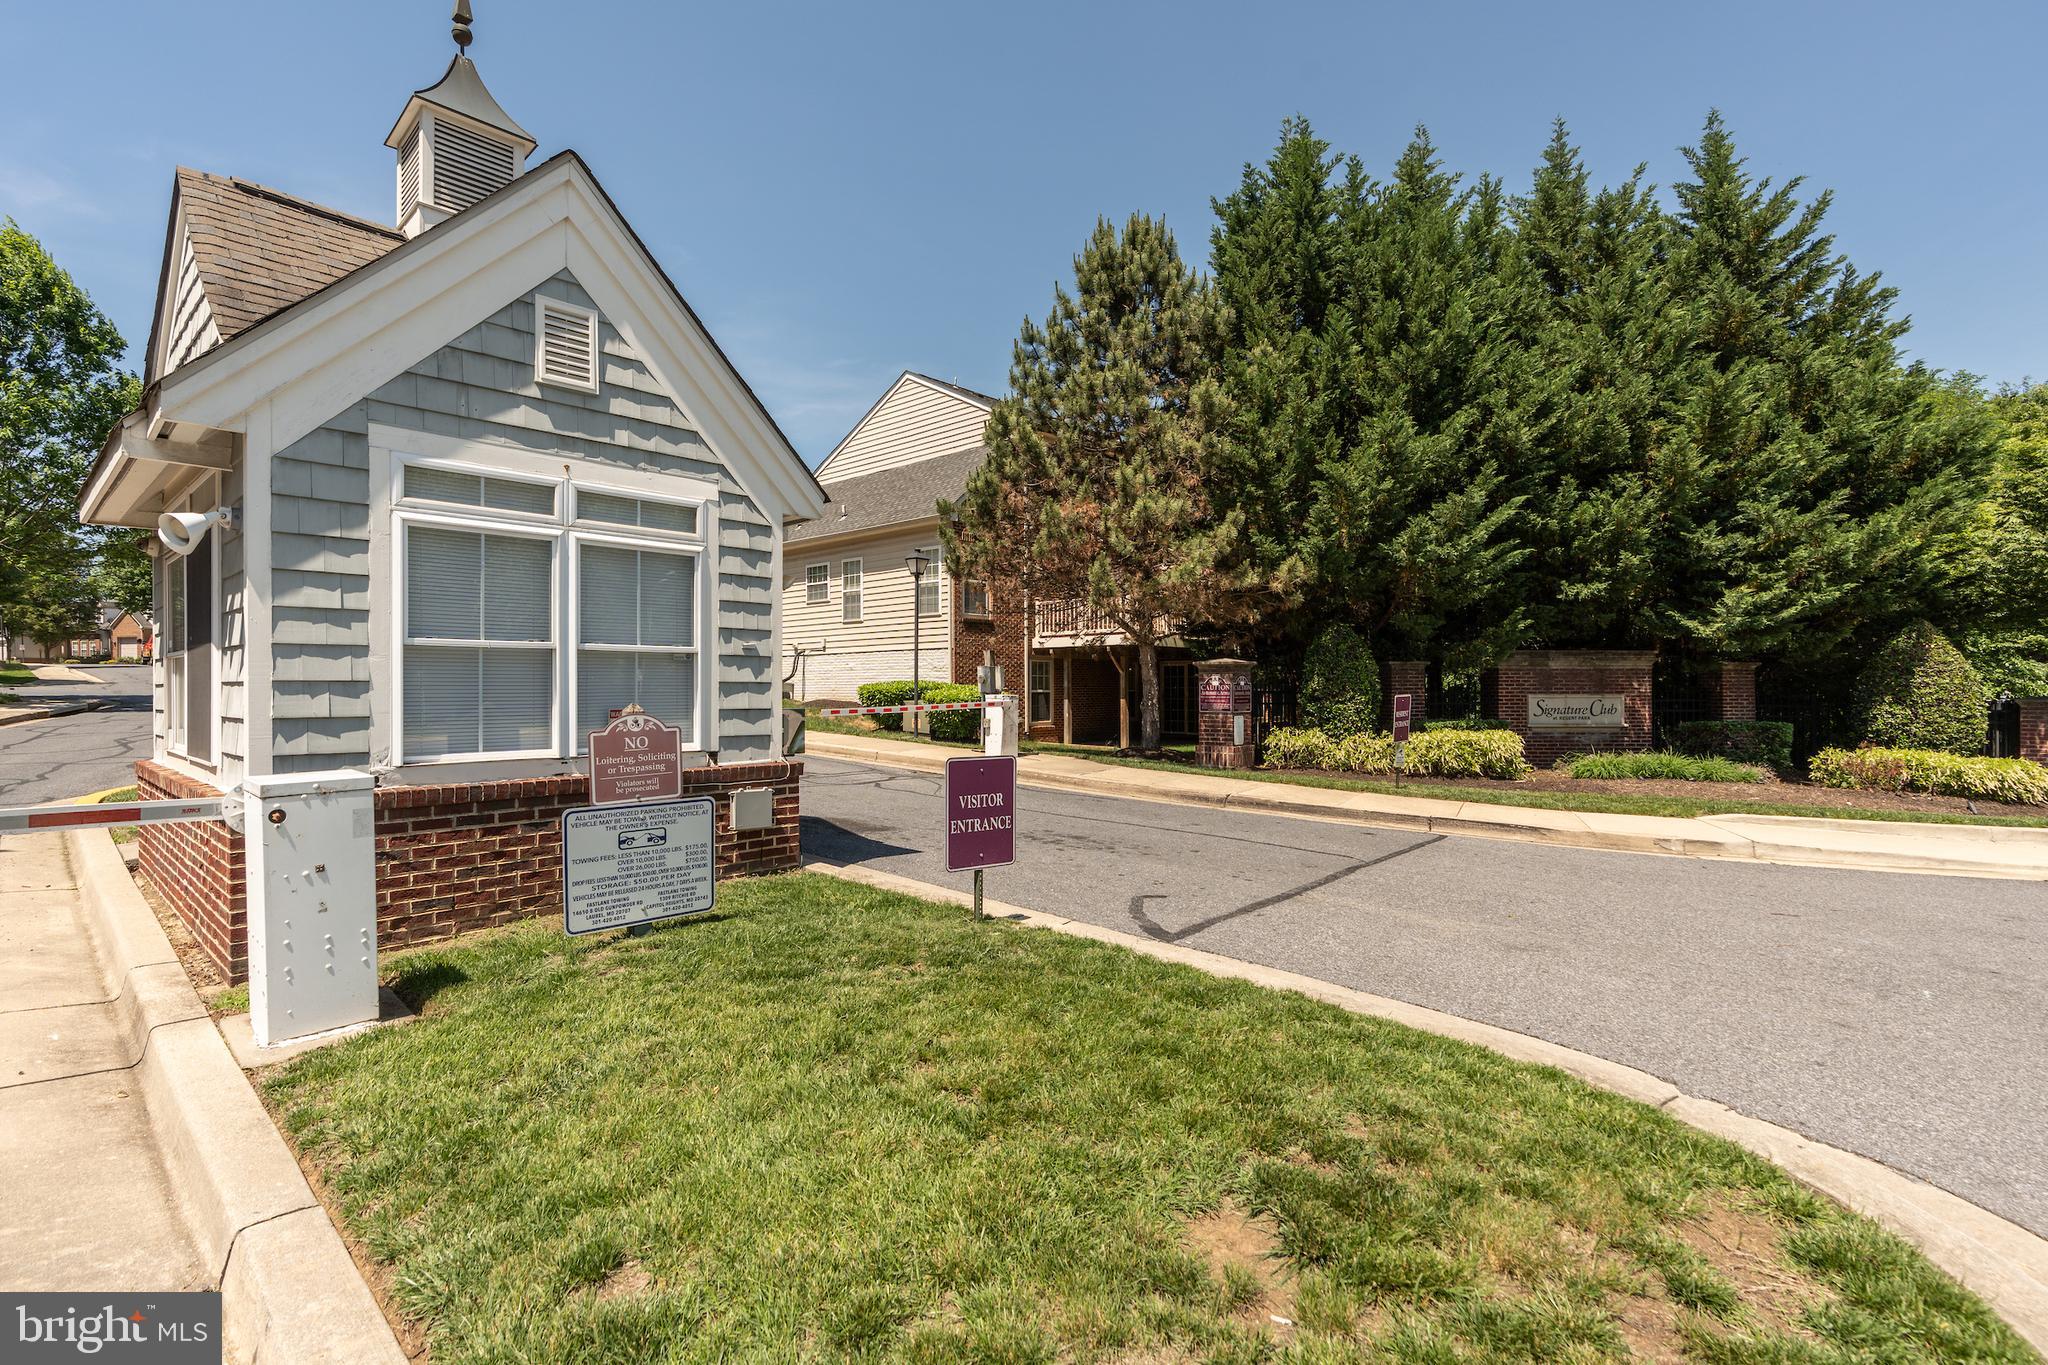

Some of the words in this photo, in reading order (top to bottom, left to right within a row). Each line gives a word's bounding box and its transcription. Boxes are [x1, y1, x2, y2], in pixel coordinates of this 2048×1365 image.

[1533, 699, 1588, 718] Signature
[1590, 699, 1618, 716] Club
[624, 736, 649, 750] NO
[596, 755, 636, 766] Loitering,
[638, 752, 676, 762] Soliciting
[618, 762, 666, 774] Trespassing
[616, 779, 646, 788] Violators
[625, 784, 660, 794] prosecuted
[959, 792, 1004, 809] VISITOR
[588, 810, 639, 820] UNAUTHORIZED
[619, 822, 648, 830] OWNER'S
[650, 819, 678, 827] EXPENSE.
[950, 816, 1012, 834] ENTRANCE
[572, 857, 599, 865] TOWING
[652, 847, 670, 855] 10,000
[636, 855, 654, 863] 10,000
[592, 880, 632, 892] STORAGE:
[634, 876, 659, 885] $50.00
[572, 893, 596, 902] VEHICLES
[615, 887, 638, 895] RELEASED
[586, 900, 610, 908] FASTLANE
[606, 901, 636, 910] GUNPOWDER
